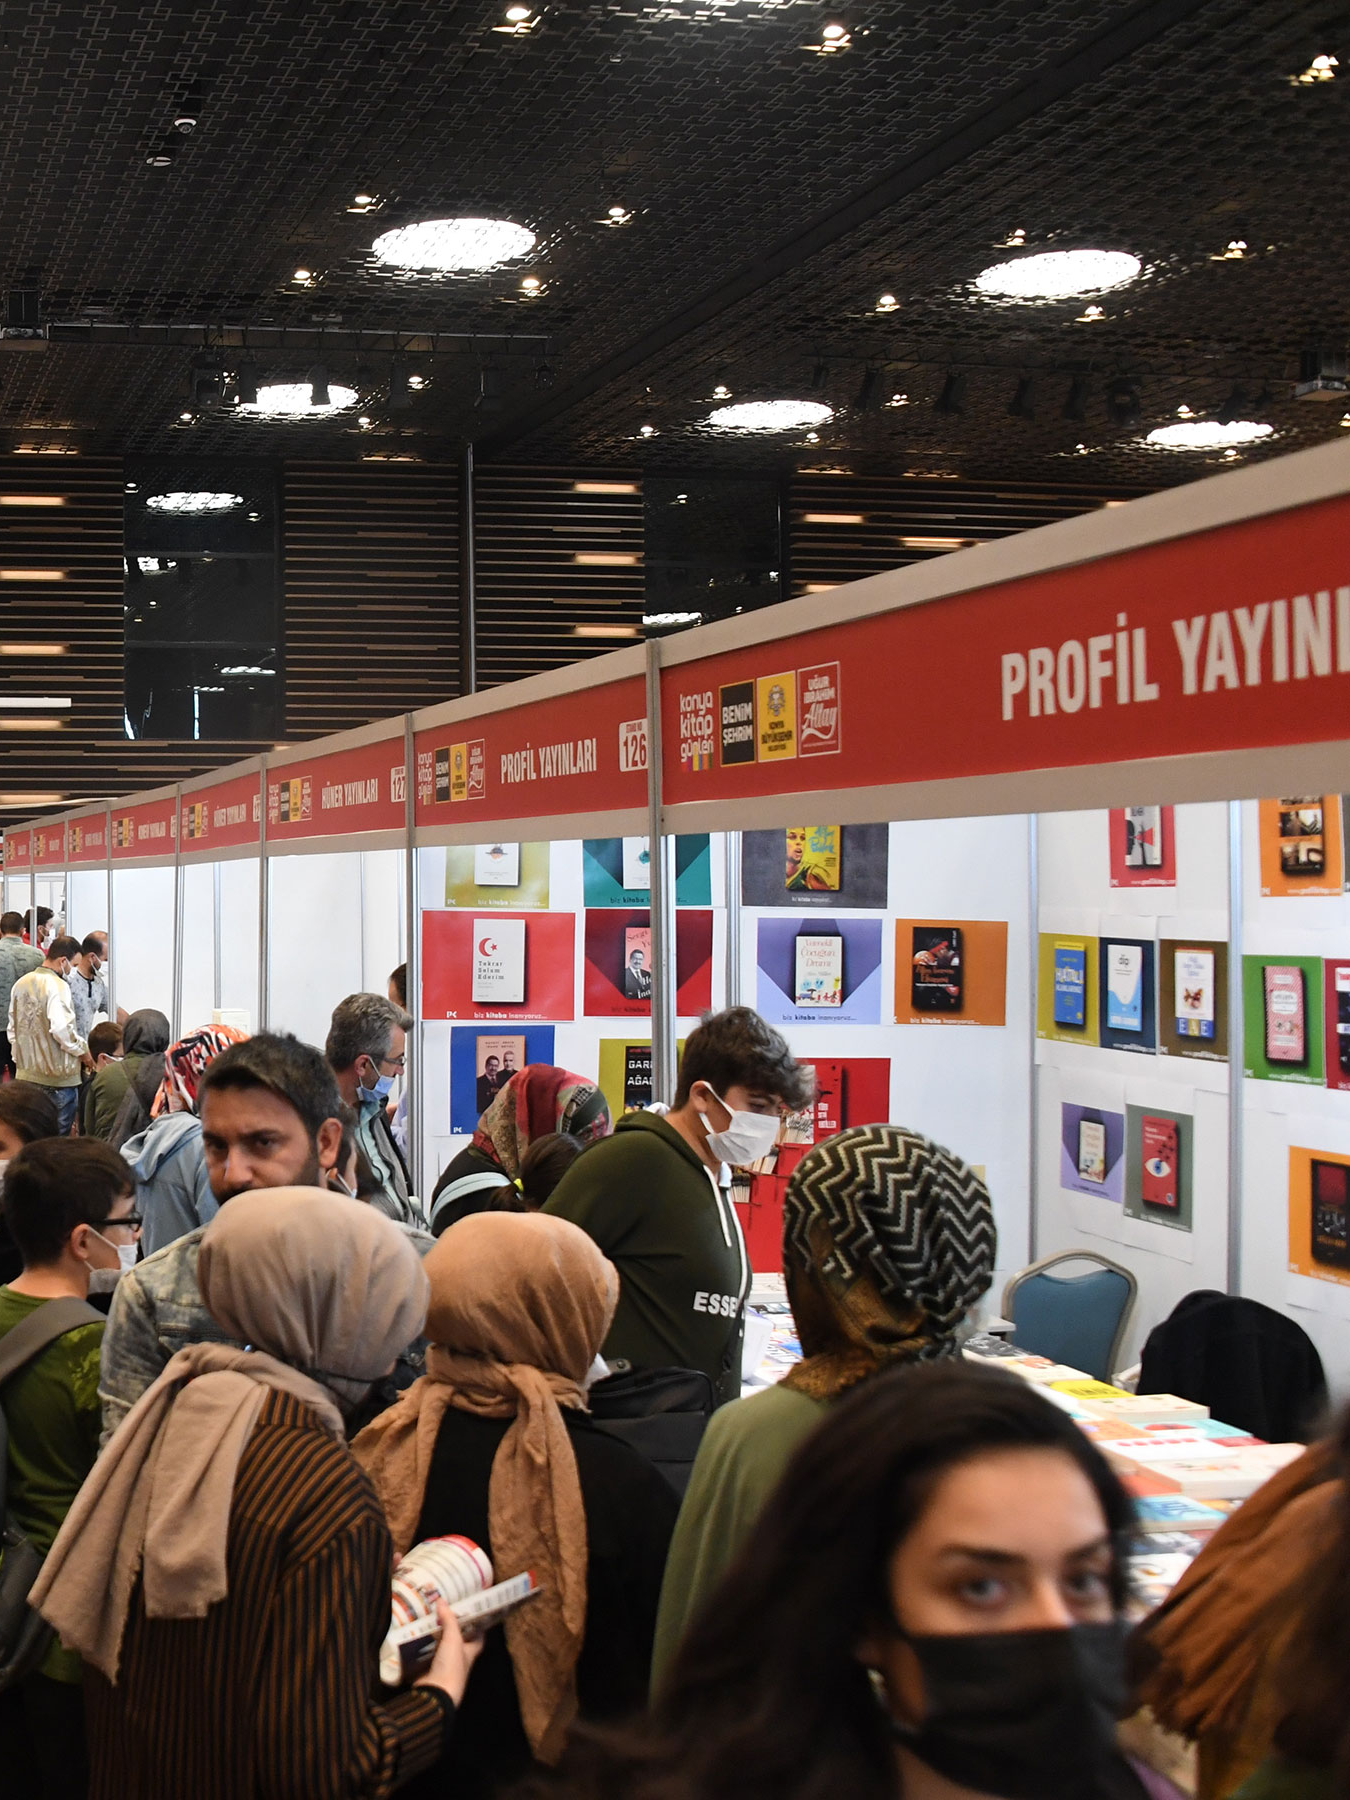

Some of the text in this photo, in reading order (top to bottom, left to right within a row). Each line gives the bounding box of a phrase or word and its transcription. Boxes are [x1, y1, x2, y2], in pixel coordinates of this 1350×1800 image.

[1001, 612, 1159, 721] PROFİL
[680, 691, 713, 715] konya
[680, 714, 713, 739] kitap
[501, 738, 597, 784] PROFİL YAYINLARI
[623, 733, 647, 769] 126
